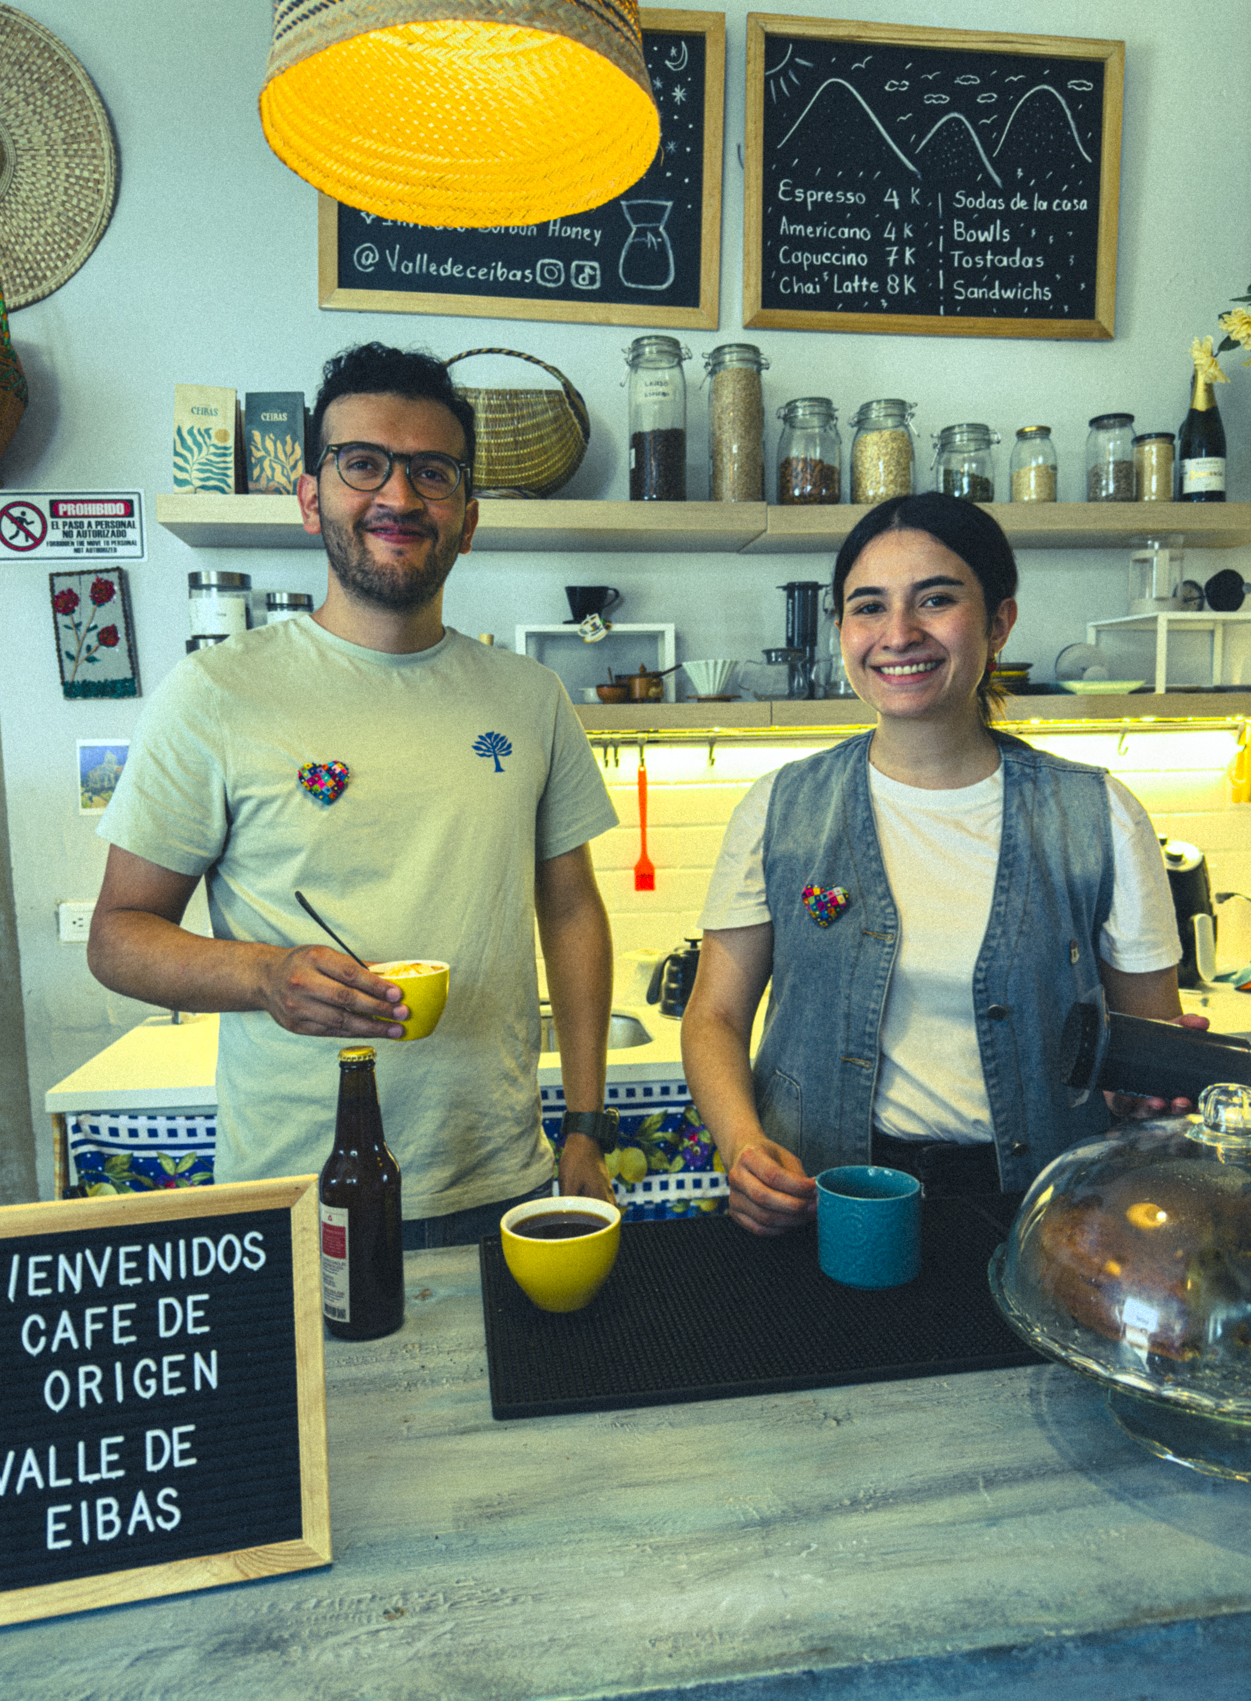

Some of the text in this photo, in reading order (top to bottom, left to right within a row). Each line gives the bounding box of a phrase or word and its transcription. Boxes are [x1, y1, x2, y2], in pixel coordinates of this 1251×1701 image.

[778, 179, 866, 211] Espresso
[953, 190, 1088, 211] Sodas de la casa
[548, 217, 602, 247] Honey
[780, 215, 871, 241] Americano
[953, 218, 1010, 242] Bowls
[779, 245, 868, 271] Capuccino
[950, 246, 1044, 268] Tostadas
[779, 275, 821, 294] Chai
[833, 273, 879, 293] Latte
[953, 280, 1052, 300] Sandwichs
[190, 406, 219, 417] CEIBAS
[260, 412, 288, 422] CEIBAS
[58, 503, 125, 516] PROHIBIDO
[51, 520, 137, 530] EL PASO A PERSONAL
[62, 529, 127, 538] NO AUTORIZADO
[21, 1294, 210, 1356] CAFE DE
[44, 1350, 218, 1412] ORIGEN
[146, 1424, 197, 1472] DE
[47, 1487, 182, 1550] EIBAS
